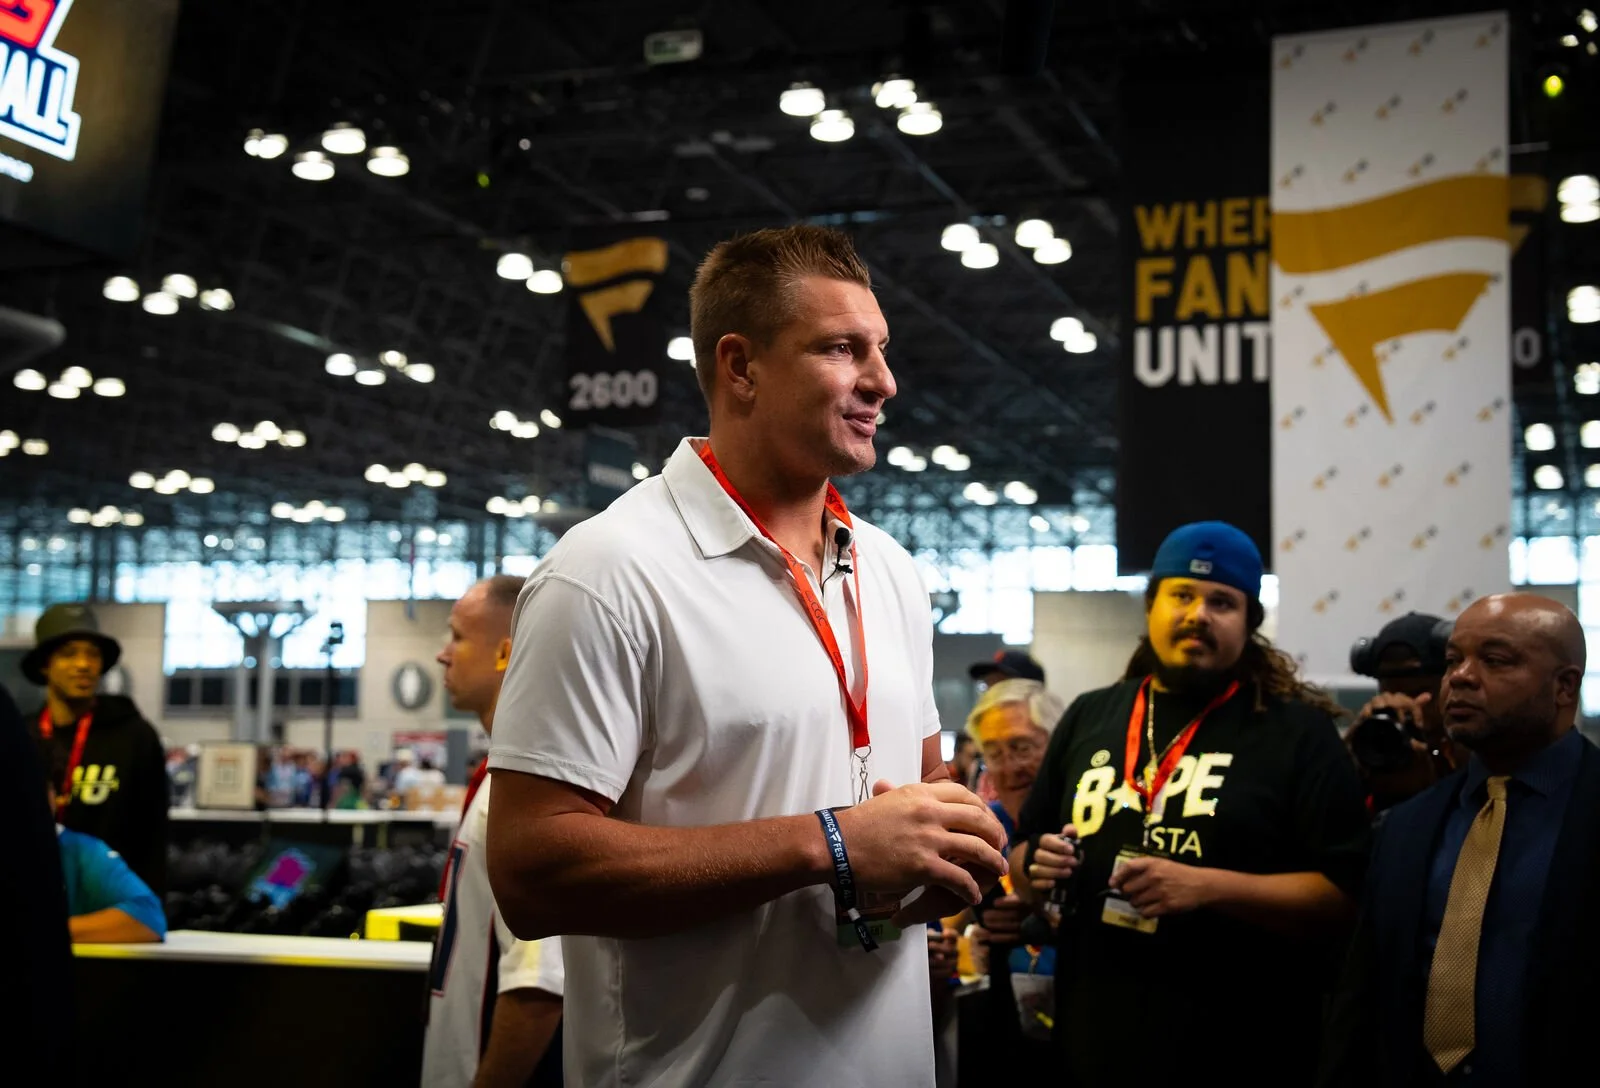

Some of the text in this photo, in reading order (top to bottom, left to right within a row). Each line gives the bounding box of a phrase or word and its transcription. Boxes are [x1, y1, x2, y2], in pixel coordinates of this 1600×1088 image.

[569, 370, 658, 410] 2600
[833, 843, 845, 862] FEST
[836, 862, 852, 885] NYC
